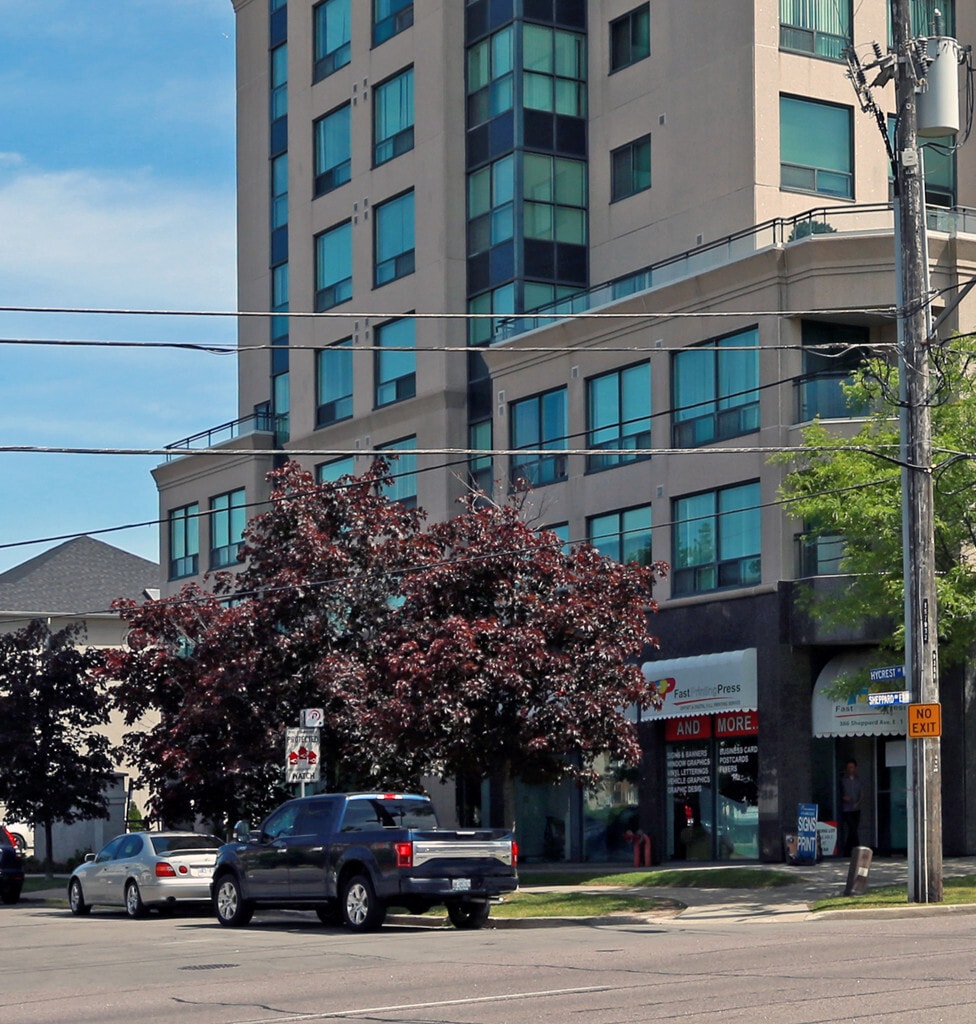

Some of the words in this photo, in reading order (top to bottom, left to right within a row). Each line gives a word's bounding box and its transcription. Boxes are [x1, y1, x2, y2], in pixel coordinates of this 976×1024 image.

[870, 668, 896, 680] HYCREST
[674, 689, 690, 698] Fast
[717, 684, 741, 694] Press
[868, 694, 894, 706] SHEPPARD
[916, 708, 932, 719] NO
[676, 720, 700, 735] AND
[851, 719, 879, 727] Sheppard
[912, 721, 936, 733] EXIT
[687, 758, 711, 766] GRAPHICS
[720, 755, 749, 764] POSTCARDS
[687, 776, 711, 784] GRAPHICS
[798, 816, 817, 832] SIGNS
[797, 836, 816, 852] PRINT
